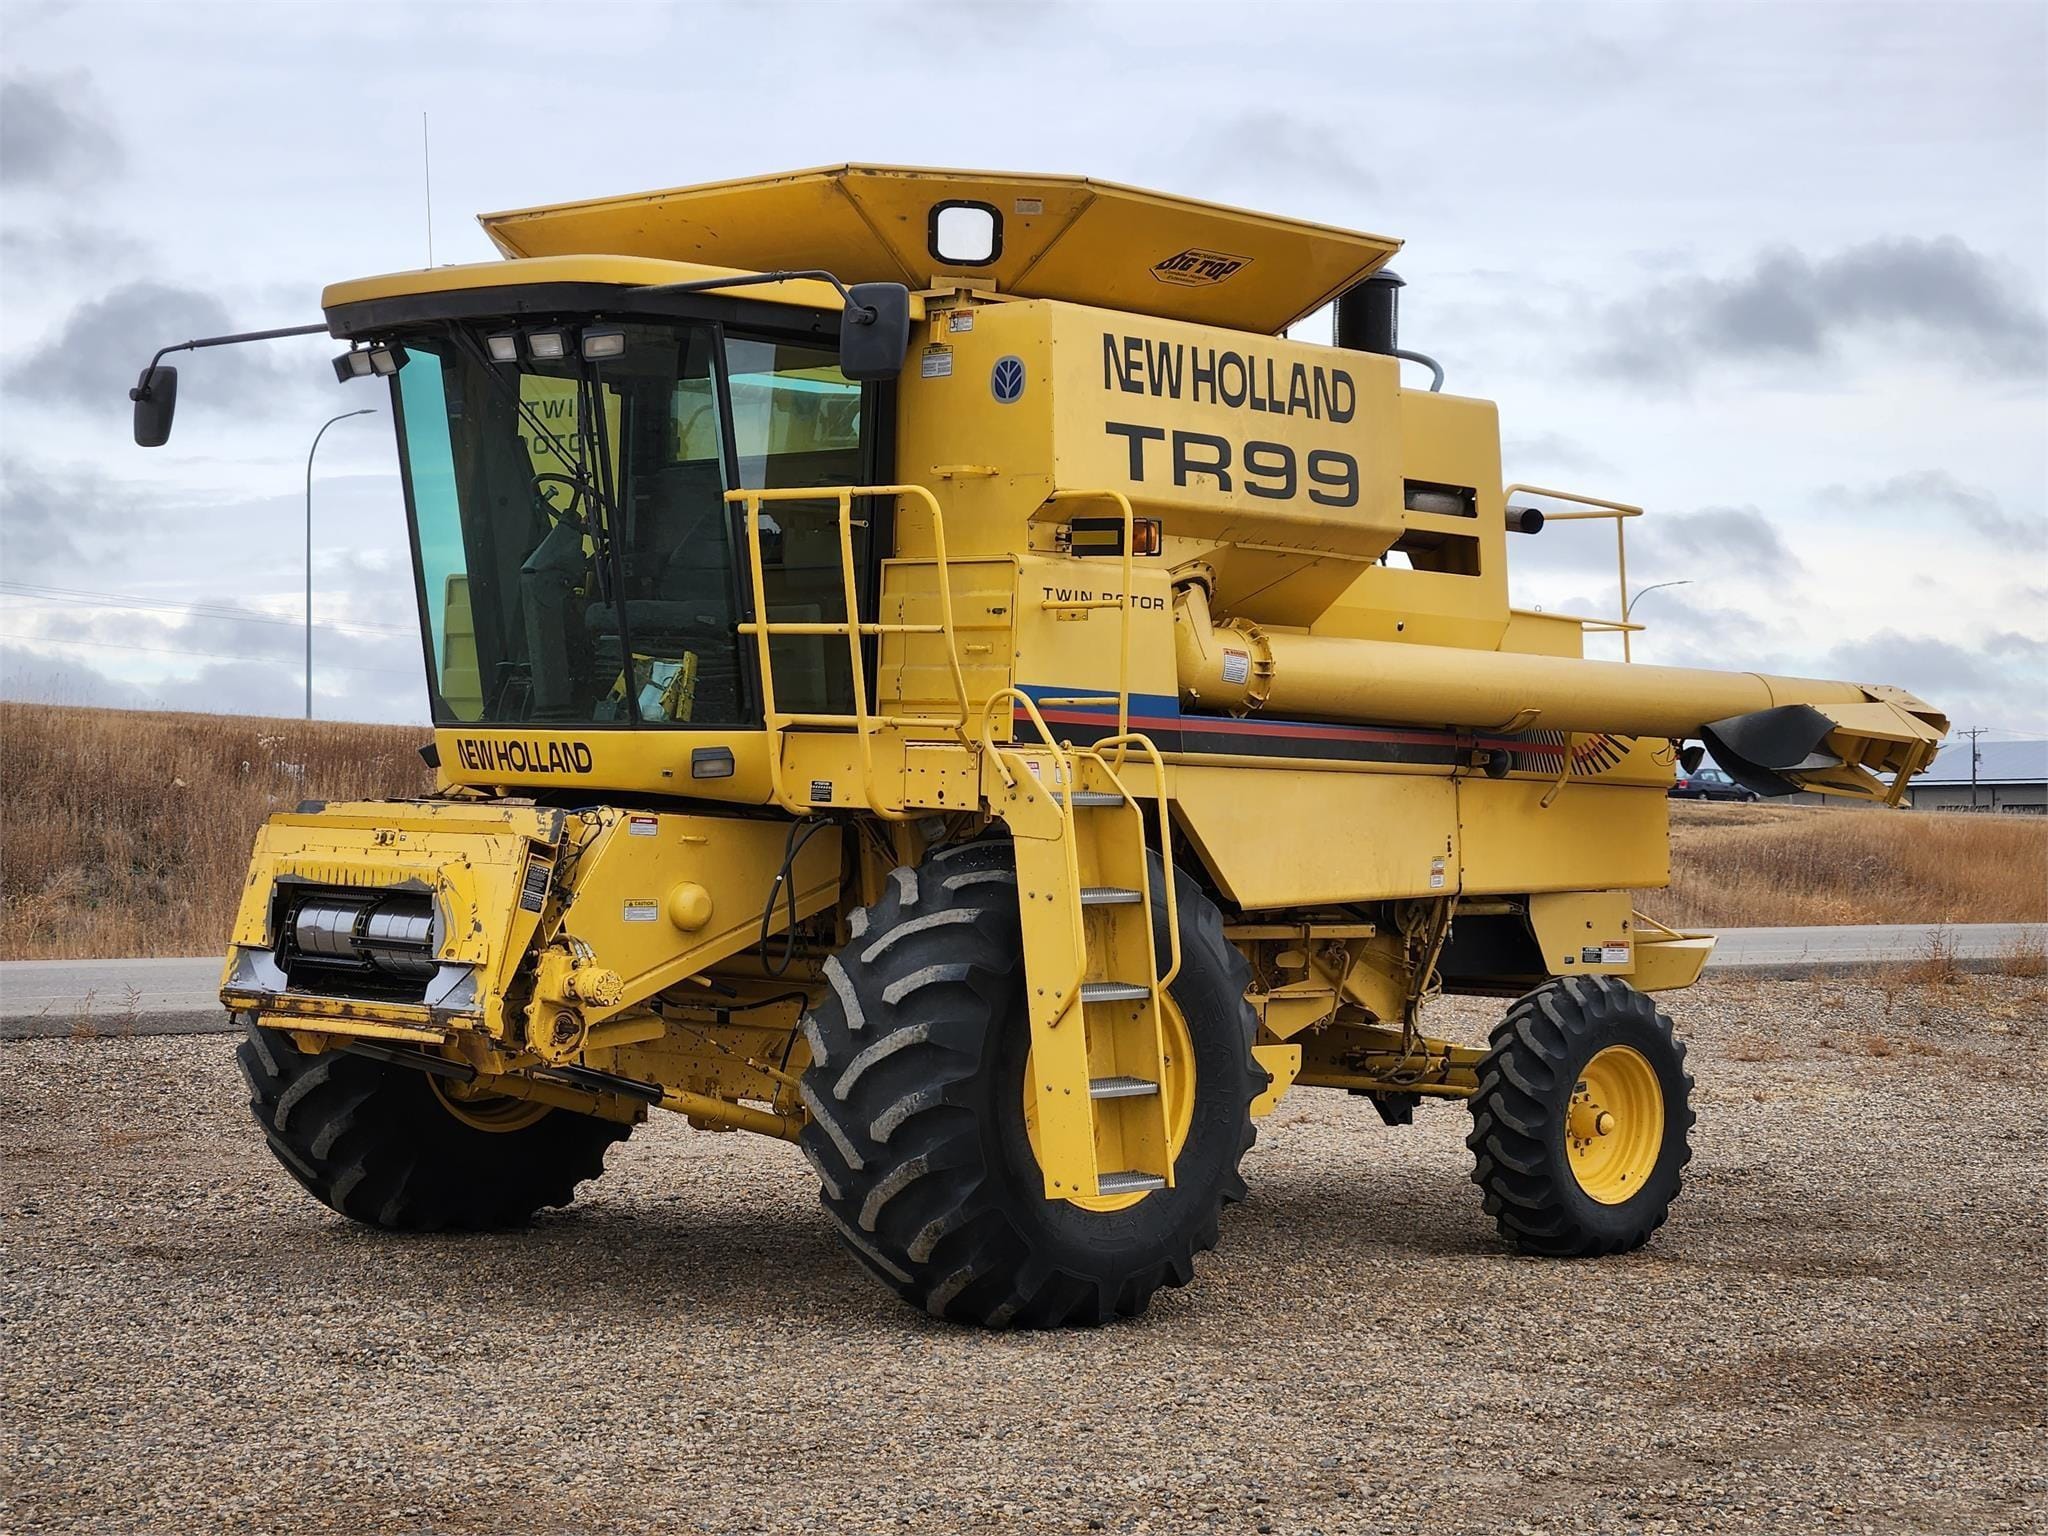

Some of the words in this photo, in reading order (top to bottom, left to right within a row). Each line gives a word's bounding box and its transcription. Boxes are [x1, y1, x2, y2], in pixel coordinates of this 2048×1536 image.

[1195, 260, 1242, 280] TOP
[1103, 333, 1183, 399] NEW
[1192, 346, 1356, 423] HOLLAND
[526, 398, 593, 420] TWI
[1105, 421, 1359, 507] TR99
[1043, 587, 1093, 602] TWIN
[457, 739, 496, 770] NEW
[495, 741, 593, 773] HOLLAND
